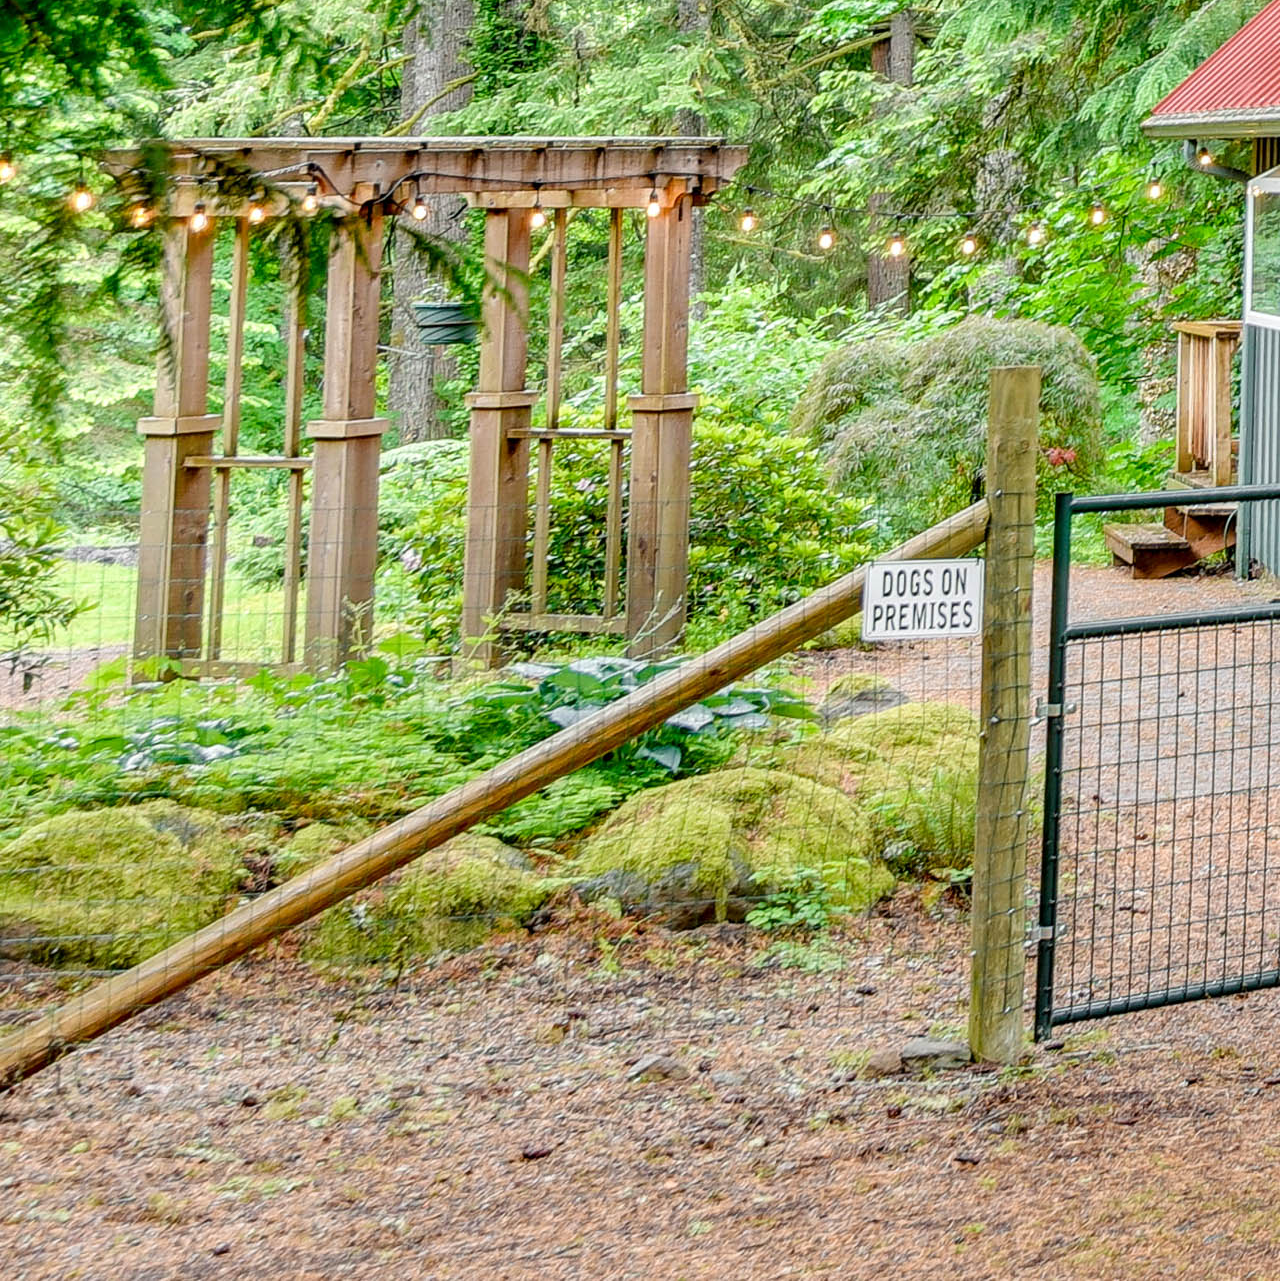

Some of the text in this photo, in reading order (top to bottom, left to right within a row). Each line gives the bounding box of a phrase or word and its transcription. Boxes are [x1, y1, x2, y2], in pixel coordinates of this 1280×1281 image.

[882, 568, 968, 597] DOGS ON
[872, 600, 973, 631] PREMISES
